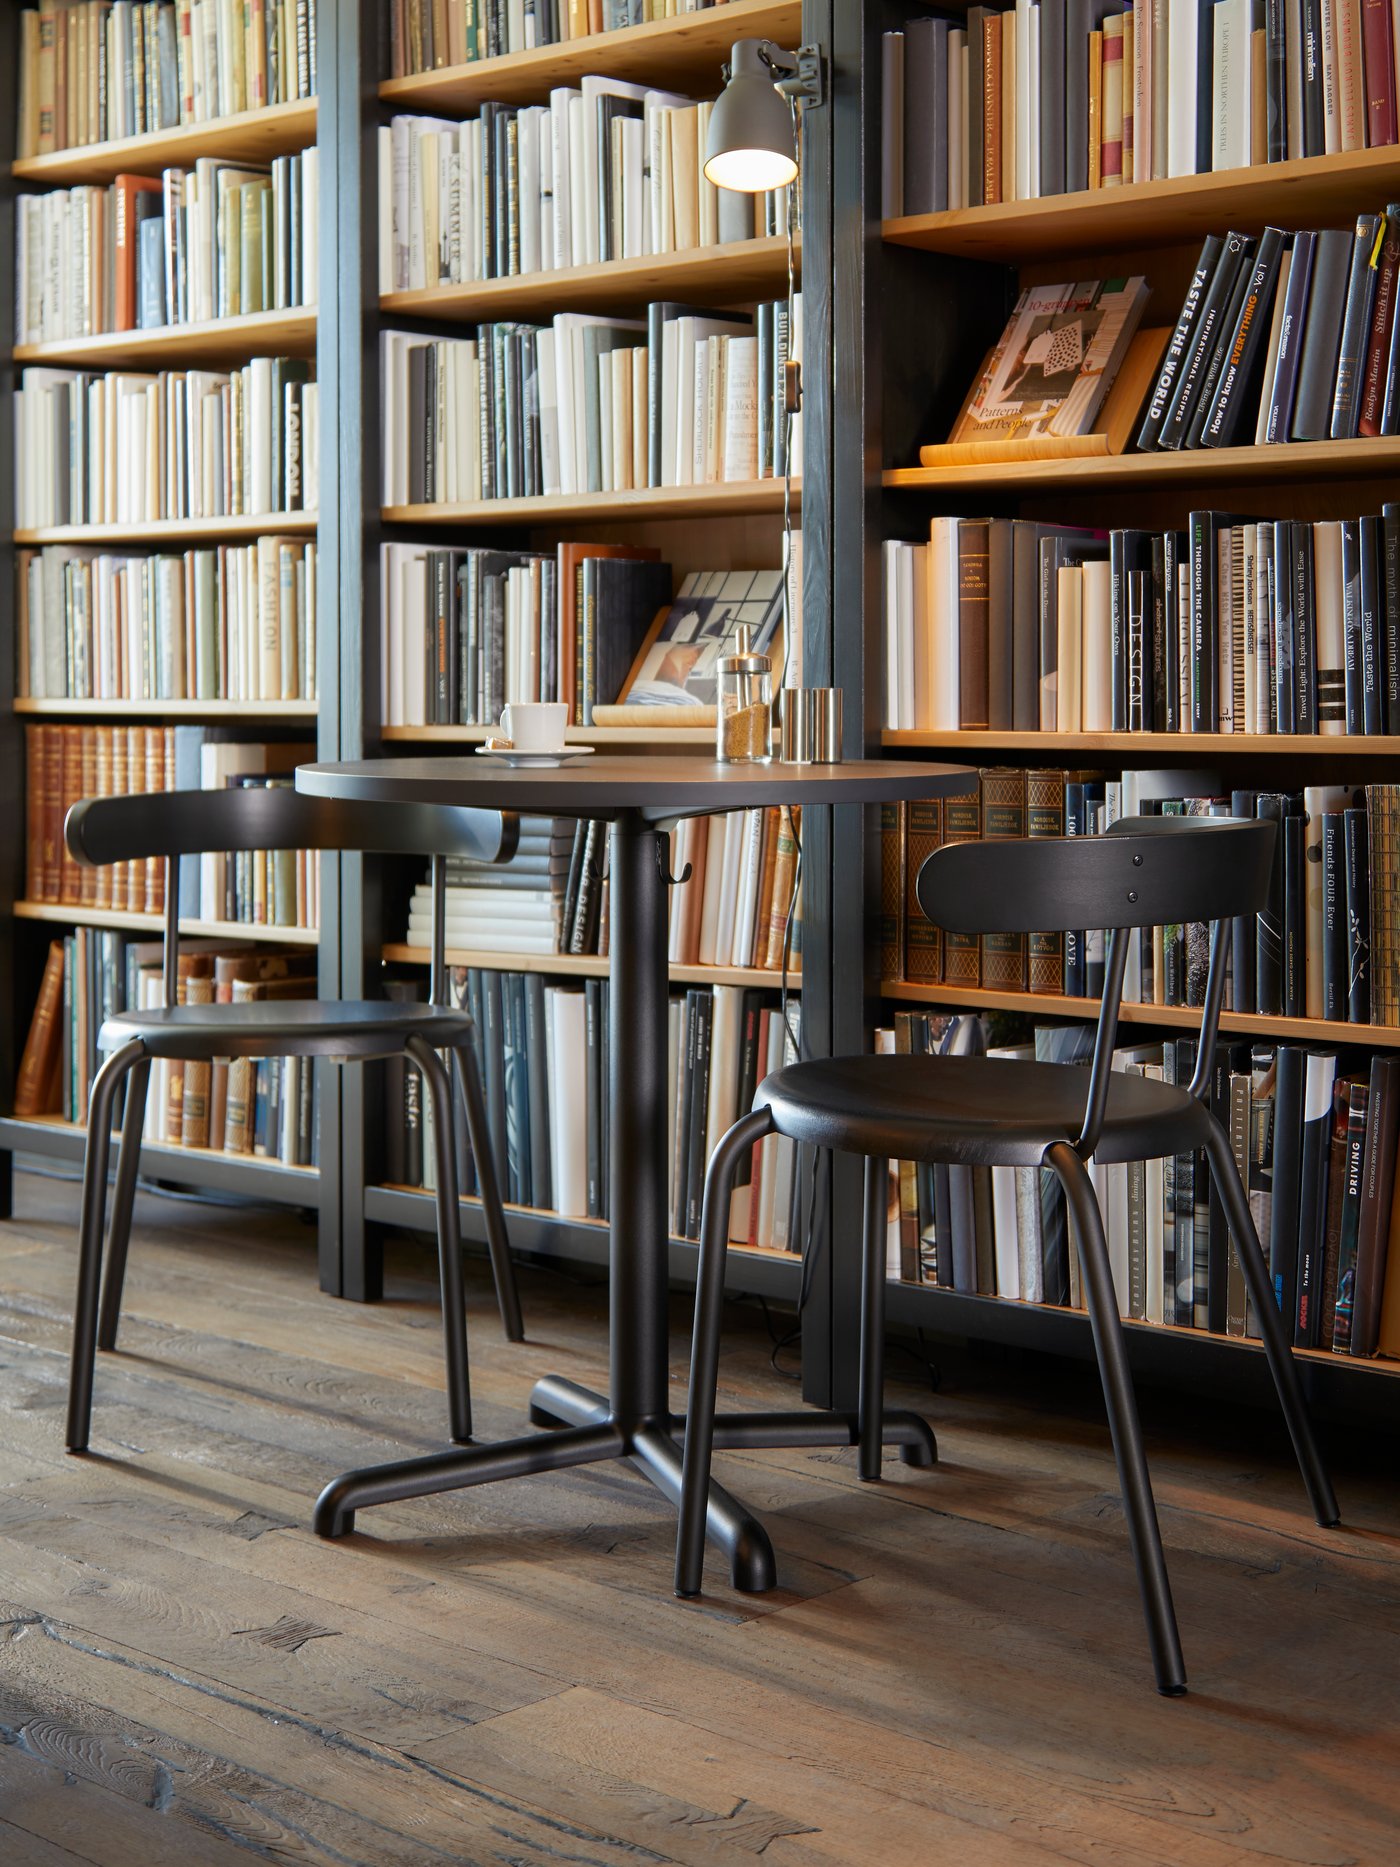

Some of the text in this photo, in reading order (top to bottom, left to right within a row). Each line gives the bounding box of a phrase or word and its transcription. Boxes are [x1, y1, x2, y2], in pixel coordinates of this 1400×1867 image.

[1136, 22, 1144, 59] Svensson
[1343, 13, 1351, 56] BROWNS
[1307, 32, 1316, 81] minimalism
[986, 68, 994, 92] OCH
[1136, 66, 1144, 107] Frostviken
[986, 93, 994, 131] VINTER
[1220, 114, 1227, 124] IN
[1346, 105, 1355, 142] JAMES
[450, 178, 460, 259] SUMMER
[1029, 297, 1092, 312] 10-gruppen
[1376, 268, 1393, 334] Stitch it up
[777, 312, 788, 373] BUILDING
[1150, 269, 1207, 420] TASTE THE WORLD
[1210, 272, 1265, 434] How to know EVERYTHING Vol
[1280, 315, 1293, 359] facts&reason
[479, 362, 487, 393] MYTH
[1175, 309, 1216, 422] INSPIRATIONAL RECIPES
[1198, 346, 1224, 413] Living Wild Life
[1365, 348, 1381, 421] Roslyn Martin
[480, 395, 487, 410] OF
[696, 352, 704, 465] SHERLOCK HOLMES
[979, 407, 1024, 417] Patterns
[973, 418, 1033, 431] and People
[290, 403, 300, 496] LONDON
[480, 411, 489, 487] MINIMALISM
[789, 544, 797, 574] History
[1063, 557, 1075, 568] The
[1221, 540, 1229, 557] The
[1297, 551, 1305, 570] Ease
[438, 584, 445, 593] to
[1166, 583, 1172, 592] up
[1221, 563, 1229, 586] Chap
[1246, 555, 1255, 605] Shirley Jackson
[1297, 572, 1305, 591] with
[264, 562, 278, 650] FASHION
[438, 594, 446, 617] know
[790, 586, 798, 628] Literature
[1221, 592, 1229, 613] With
[1297, 592, 1305, 617] World
[1346, 582, 1354, 621] WALKING
[1387, 536, 1399, 701] The myth of minimalism
[438, 618, 446, 673] EVERYTHING
[1276, 602, 1285, 684] European Escapades
[1347, 621, 1354, 632] ON
[1129, 614, 1142, 707] DESIGN
[1298, 635, 1307, 666] Explore
[1364, 611, 1374, 692] Taste the World
[1298, 668, 1308, 692] Light:
[1299, 694, 1307, 720] Travel
[1108, 793, 1117, 807] The
[1030, 823, 1060, 831] FAMILJEBOK
[1327, 829, 1336, 931] Friends FOUR Ever
[572, 896, 588, 953] DESIGN
[1168, 969, 1176, 996] Wahlberg
[407, 1072, 421, 1129] taste
[1349, 1142, 1361, 1195] DRIVING
[1132, 1176, 1140, 1307] POTTERYBARN dining
[1328, 1230, 1339, 1261] love
